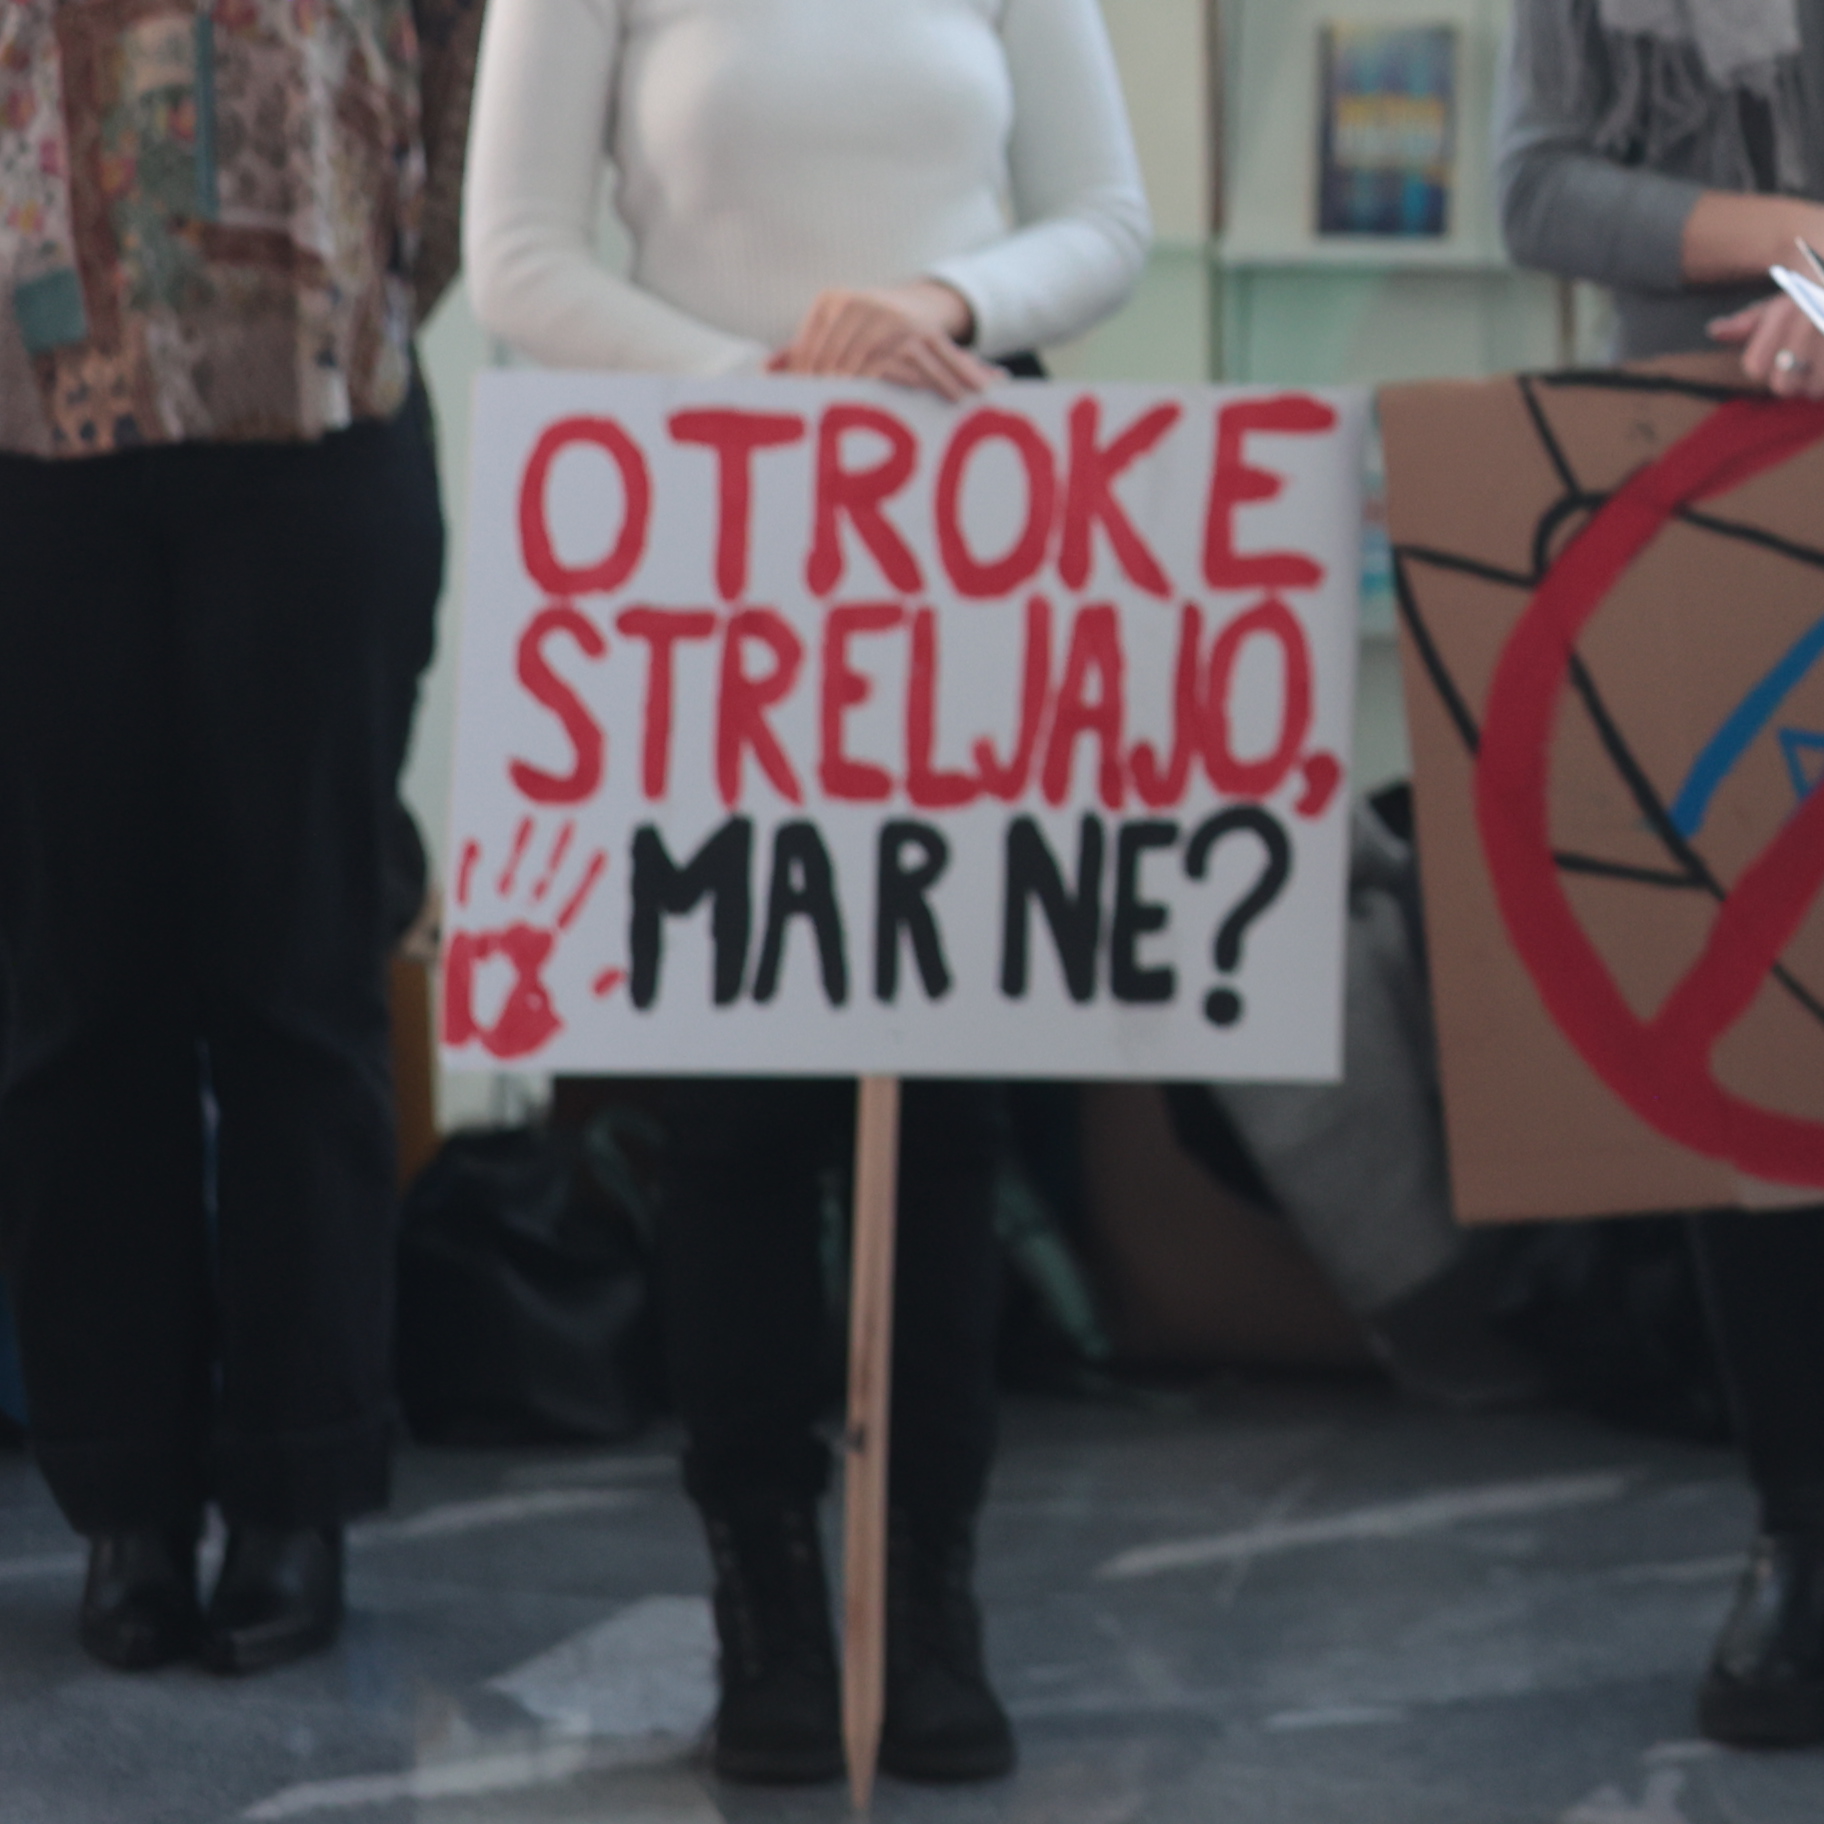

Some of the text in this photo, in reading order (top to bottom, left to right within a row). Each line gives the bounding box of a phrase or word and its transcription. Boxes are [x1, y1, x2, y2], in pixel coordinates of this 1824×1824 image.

[516, 393, 1338, 602] OTROKE
[507, 593, 1344, 821] STRELJAJO,
[628, 804, 1294, 1028] MAR NE?
